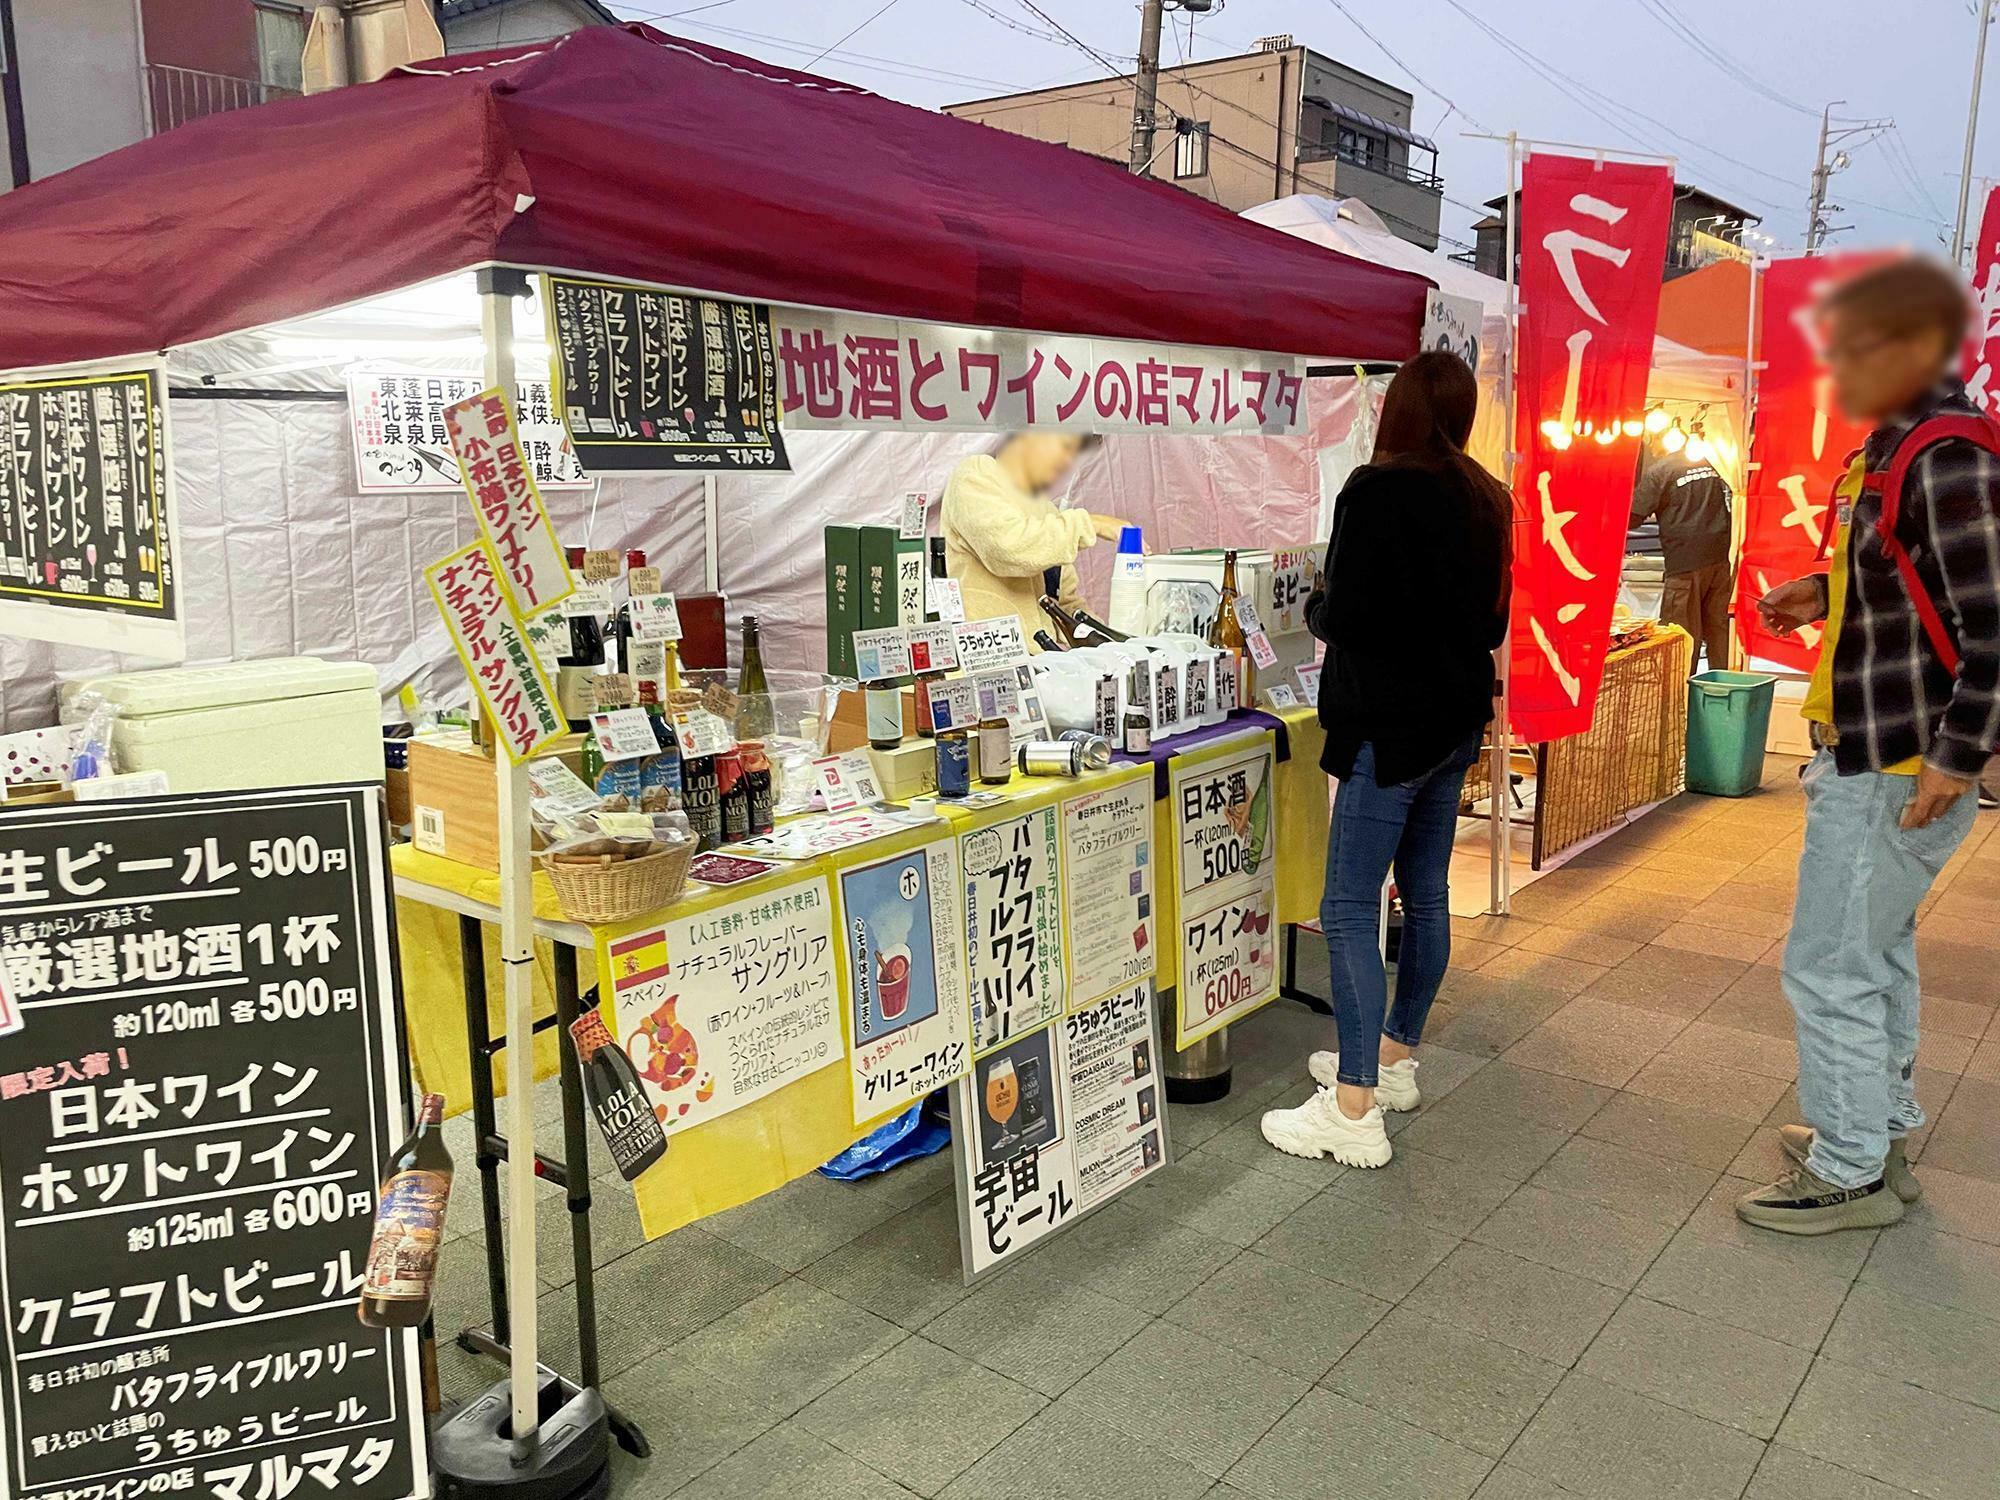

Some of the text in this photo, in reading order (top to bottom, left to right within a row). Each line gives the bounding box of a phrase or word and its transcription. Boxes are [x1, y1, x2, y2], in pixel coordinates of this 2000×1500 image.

[556, 286, 579, 391] うちゅうビール
[577, 288, 600, 406] バタフライブルワリー
[604, 290, 639, 438] クラフトビール
[640, 295, 662, 410] ホットワイン
[668, 296, 689, 409] 日本ワイン
[735, 305, 758, 400] 生ビール
[378, 376, 403, 445] 東北泉
[401, 377, 426, 445] 蓬莱泉
[530, 383, 548, 425] 義侠
[778, 327, 1303, 427] 地酒とワインの店マルマタ
[42, 393, 67, 545] ホットワイン
[67, 391, 92, 546] 日本ワイン
[129, 384, 153, 532] 生ビール
[533, 441, 552, 482] 酔鯨
[726, 448, 775, 465] マルマタ
[1529, 193, 1631, 707] ラーメン
[12, 393, 44, 585] クラフトビール
[497, 441, 542, 532] 日本ワイン
[462, 437, 538, 606] 小布施ワイナリー
[467, 549, 504, 617] スペイン
[437, 565, 538, 755] ナチュラル サングリア
[958, 627, 1019, 652] うちゅうビール
[1194, 678, 1206, 714] 八海山
[1221, 672, 1235, 695] 作
[1183, 770, 1247, 824] 日本酒
[0, 835, 347, 900] 生ビール 500円
[1077, 825, 1142, 856] バタフライブルワリー
[1203, 838, 1250, 884] 500円
[903, 871, 918, 895] ホ
[1012, 815, 1038, 999] バタフライ
[3, 914, 342, 998] 厳選地酒1杯
[676, 925, 807, 981] ナチュラルフレーバー
[989, 859, 1015, 1039] ブルワリー
[1188, 905, 1250, 955] ワイン
[621, 982, 667, 1010] スペイン
[731, 935, 828, 994] サングリア
[1204, 967, 1251, 1016] 600円
[113, 977, 357, 1038] 約120ml 各500円
[1066, 985, 1145, 1040] うちゅうビール
[50, 1061, 320, 1139] 日本ワイン
[597, 1081, 639, 1120] LOLA
[864, 1041, 964, 1101] グリューワイン
[910, 1059, 964, 1095] (ホットワイン)
[601, 1094, 650, 1138] MOLA
[1075, 1097, 1126, 1130] COSMIC DREAM
[20, 1126, 356, 1212] ホットワイン
[974, 1143, 1040, 1218] 宇宙
[127, 1207, 234, 1252] 約125ml
[243, 1182, 372, 1233] 各600円
[987, 1179, 1073, 1255] ビール
[17, 1249, 367, 1346] クラフトビール
[28, 1344, 171, 1393] 春日井初の醸造所
[110, 1342, 377, 1412] バタフライブルワリー
[30, 1411, 166, 1458] 買えないと話題の
[135, 1397, 367, 1463] うちゅうビール
[204, 1437, 394, 1500] マルマタ
